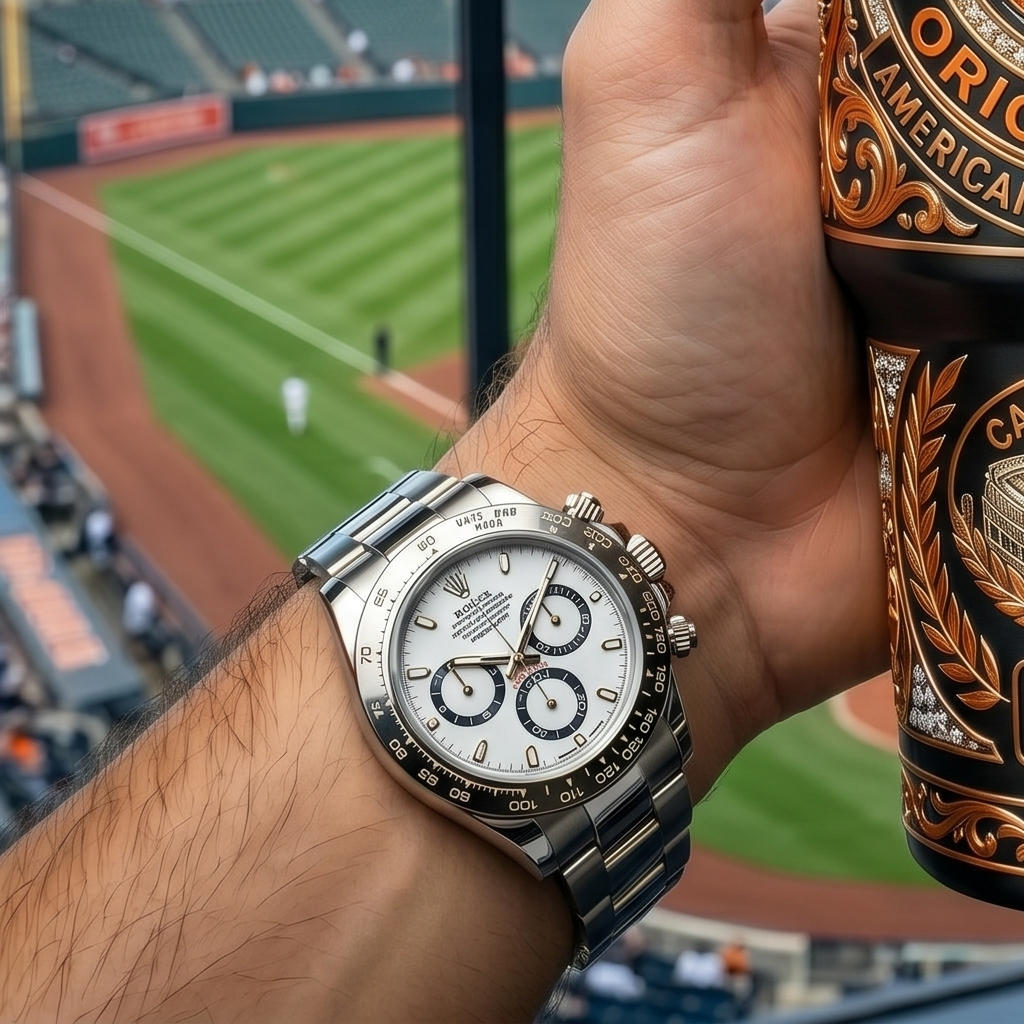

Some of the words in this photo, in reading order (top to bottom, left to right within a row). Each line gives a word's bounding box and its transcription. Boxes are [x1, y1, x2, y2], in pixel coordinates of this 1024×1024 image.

[360, 646, 372, 665] 70
[389, 738, 408, 760] 80
[595, 762, 620, 784] 120
[560, 787, 584, 803] 110
[509, 800, 538, 811] 100
